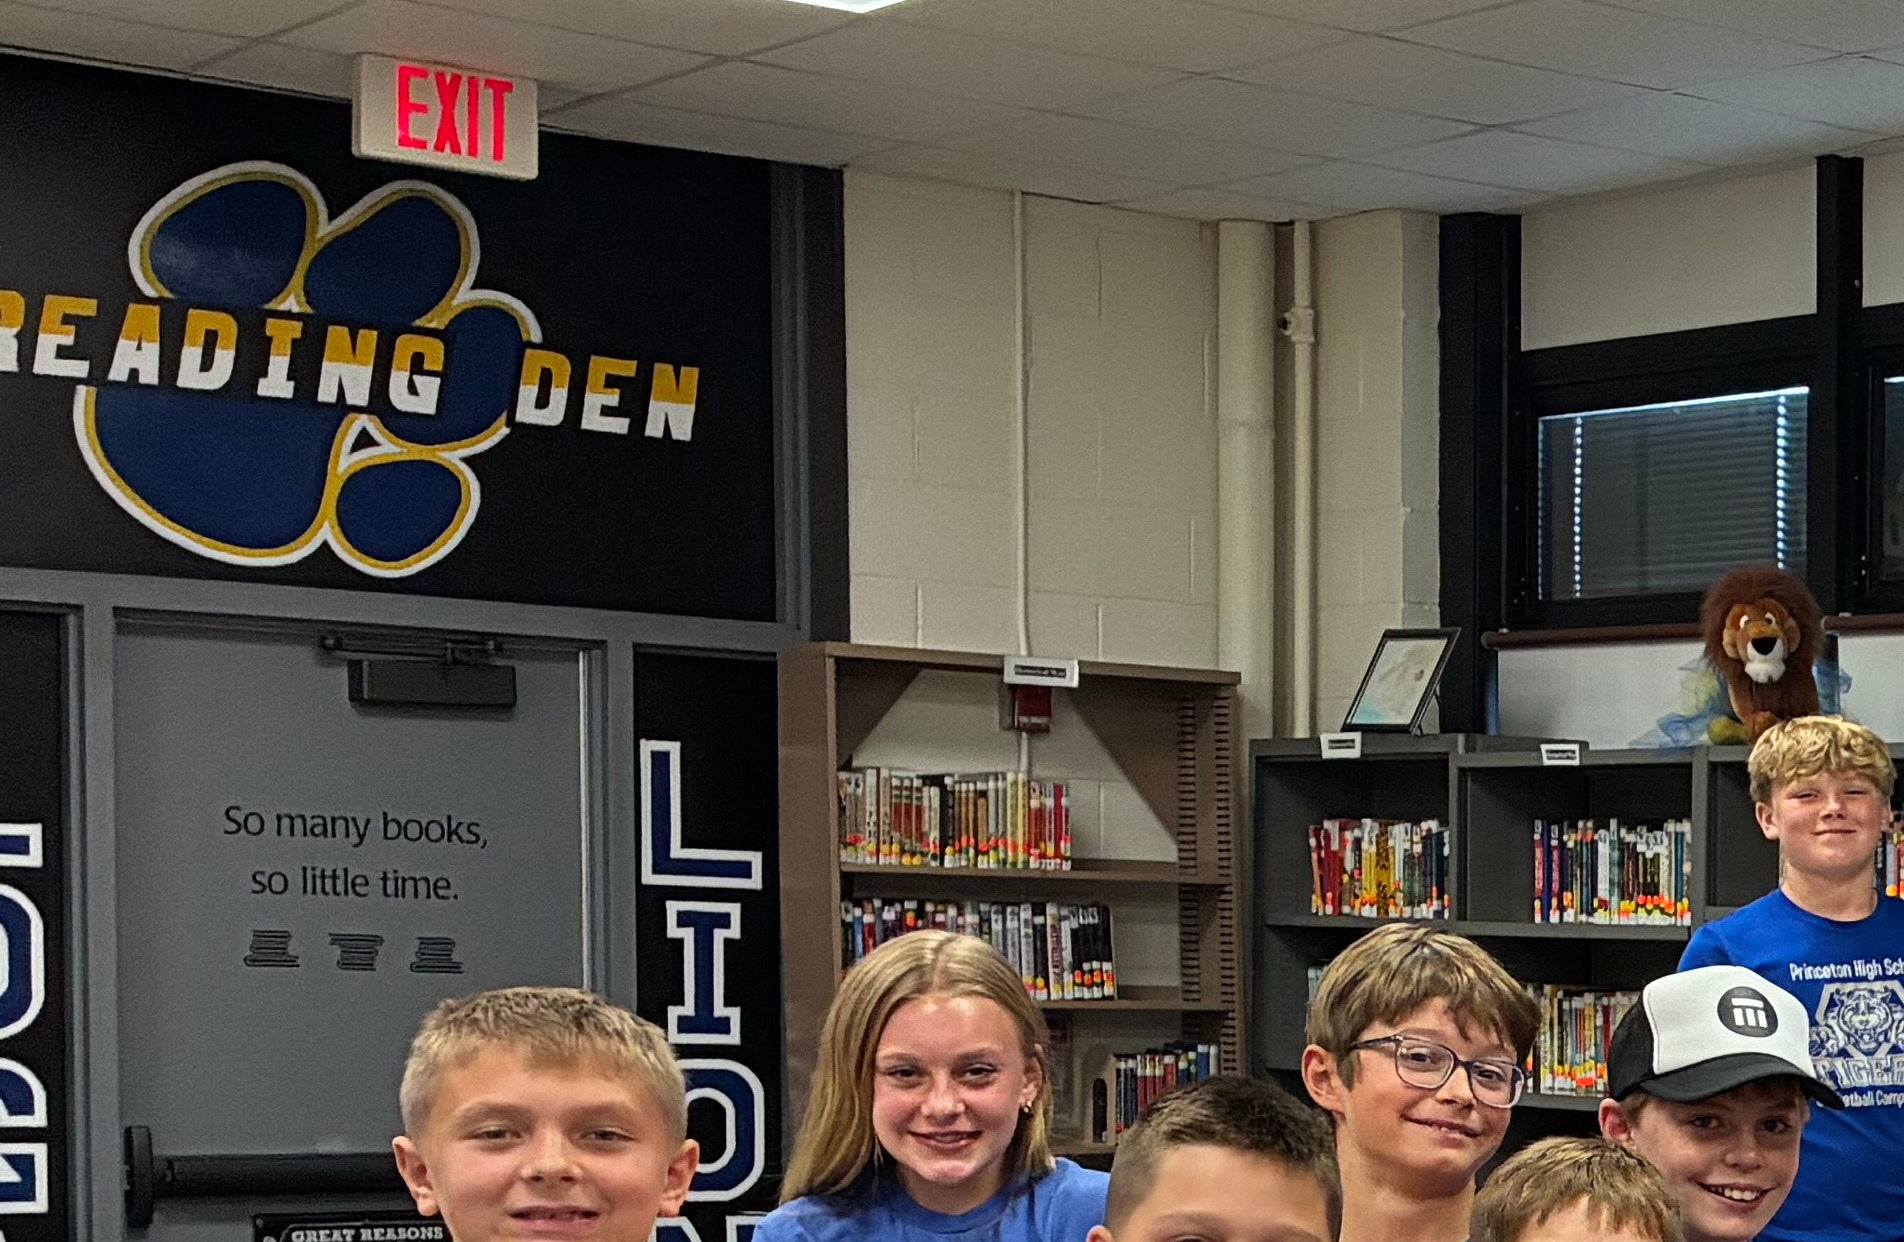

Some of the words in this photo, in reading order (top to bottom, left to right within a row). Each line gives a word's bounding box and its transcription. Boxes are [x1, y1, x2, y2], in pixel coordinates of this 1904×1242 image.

[397, 65, 513, 162] EXIT
[516, 349, 701, 442] DEN
[223, 807, 266, 838] So
[275, 812, 371, 848] many
[382, 815, 489, 850] books,
[252, 872, 289, 896] so
[301, 866, 369, 899] little
[379, 870, 460, 901] time.
[1789, 963, 1851, 981] Princeton
[1853, 959, 1882, 980] High
[291, 1229, 355, 1242] GREAT
[360, 1227, 443, 1241] REASONS
